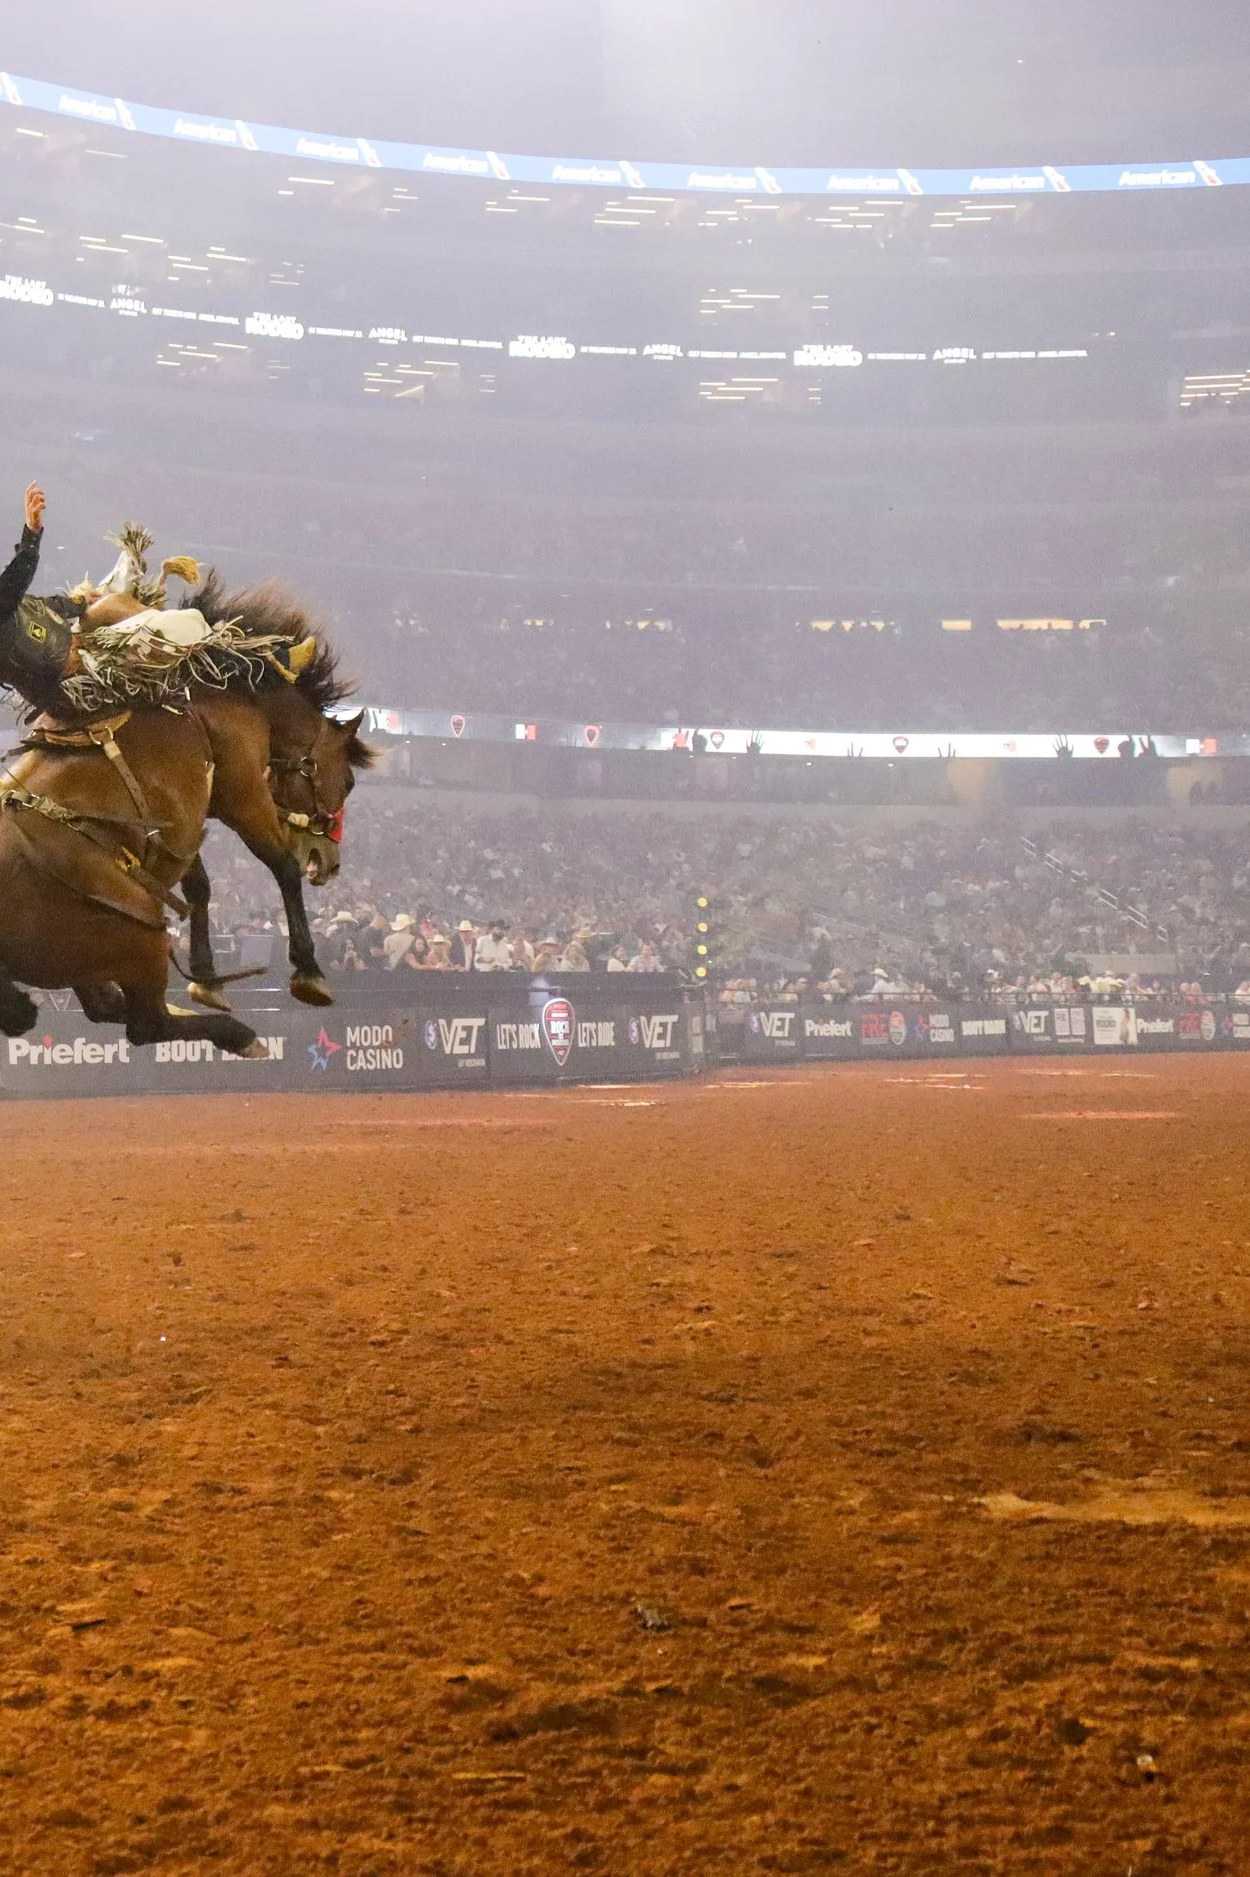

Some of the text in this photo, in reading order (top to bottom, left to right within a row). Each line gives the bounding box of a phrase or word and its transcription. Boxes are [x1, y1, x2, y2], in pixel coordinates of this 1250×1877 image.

[59, 95, 116, 121] American
[174, 119, 236, 143] American
[296, 138, 359, 161] American
[423, 152, 488, 173] American
[552, 164, 621, 183] American
[688, 172, 757, 189] American
[827, 175, 898, 190] American
[970, 176, 1044, 191] American
[1119, 170, 1195, 186] American
[110, 298, 147, 313] ANGEL
[369, 328, 408, 342] ANGEL
[639, 1014, 679, 1049] VET
[759, 1012, 795, 1037] VET
[805, 1018, 852, 1037] Priefert
[1019, 1011, 1049, 1033] VET
[346, 1025, 393, 1047] MODO
[438, 1018, 486, 1054] VET
[496, 1023, 541, 1050] LET'S ROCK
[577, 1022, 598, 1048] LET'S
[8, 1034, 130, 1065] Priefert
[346, 1048, 404, 1071] CASINO
